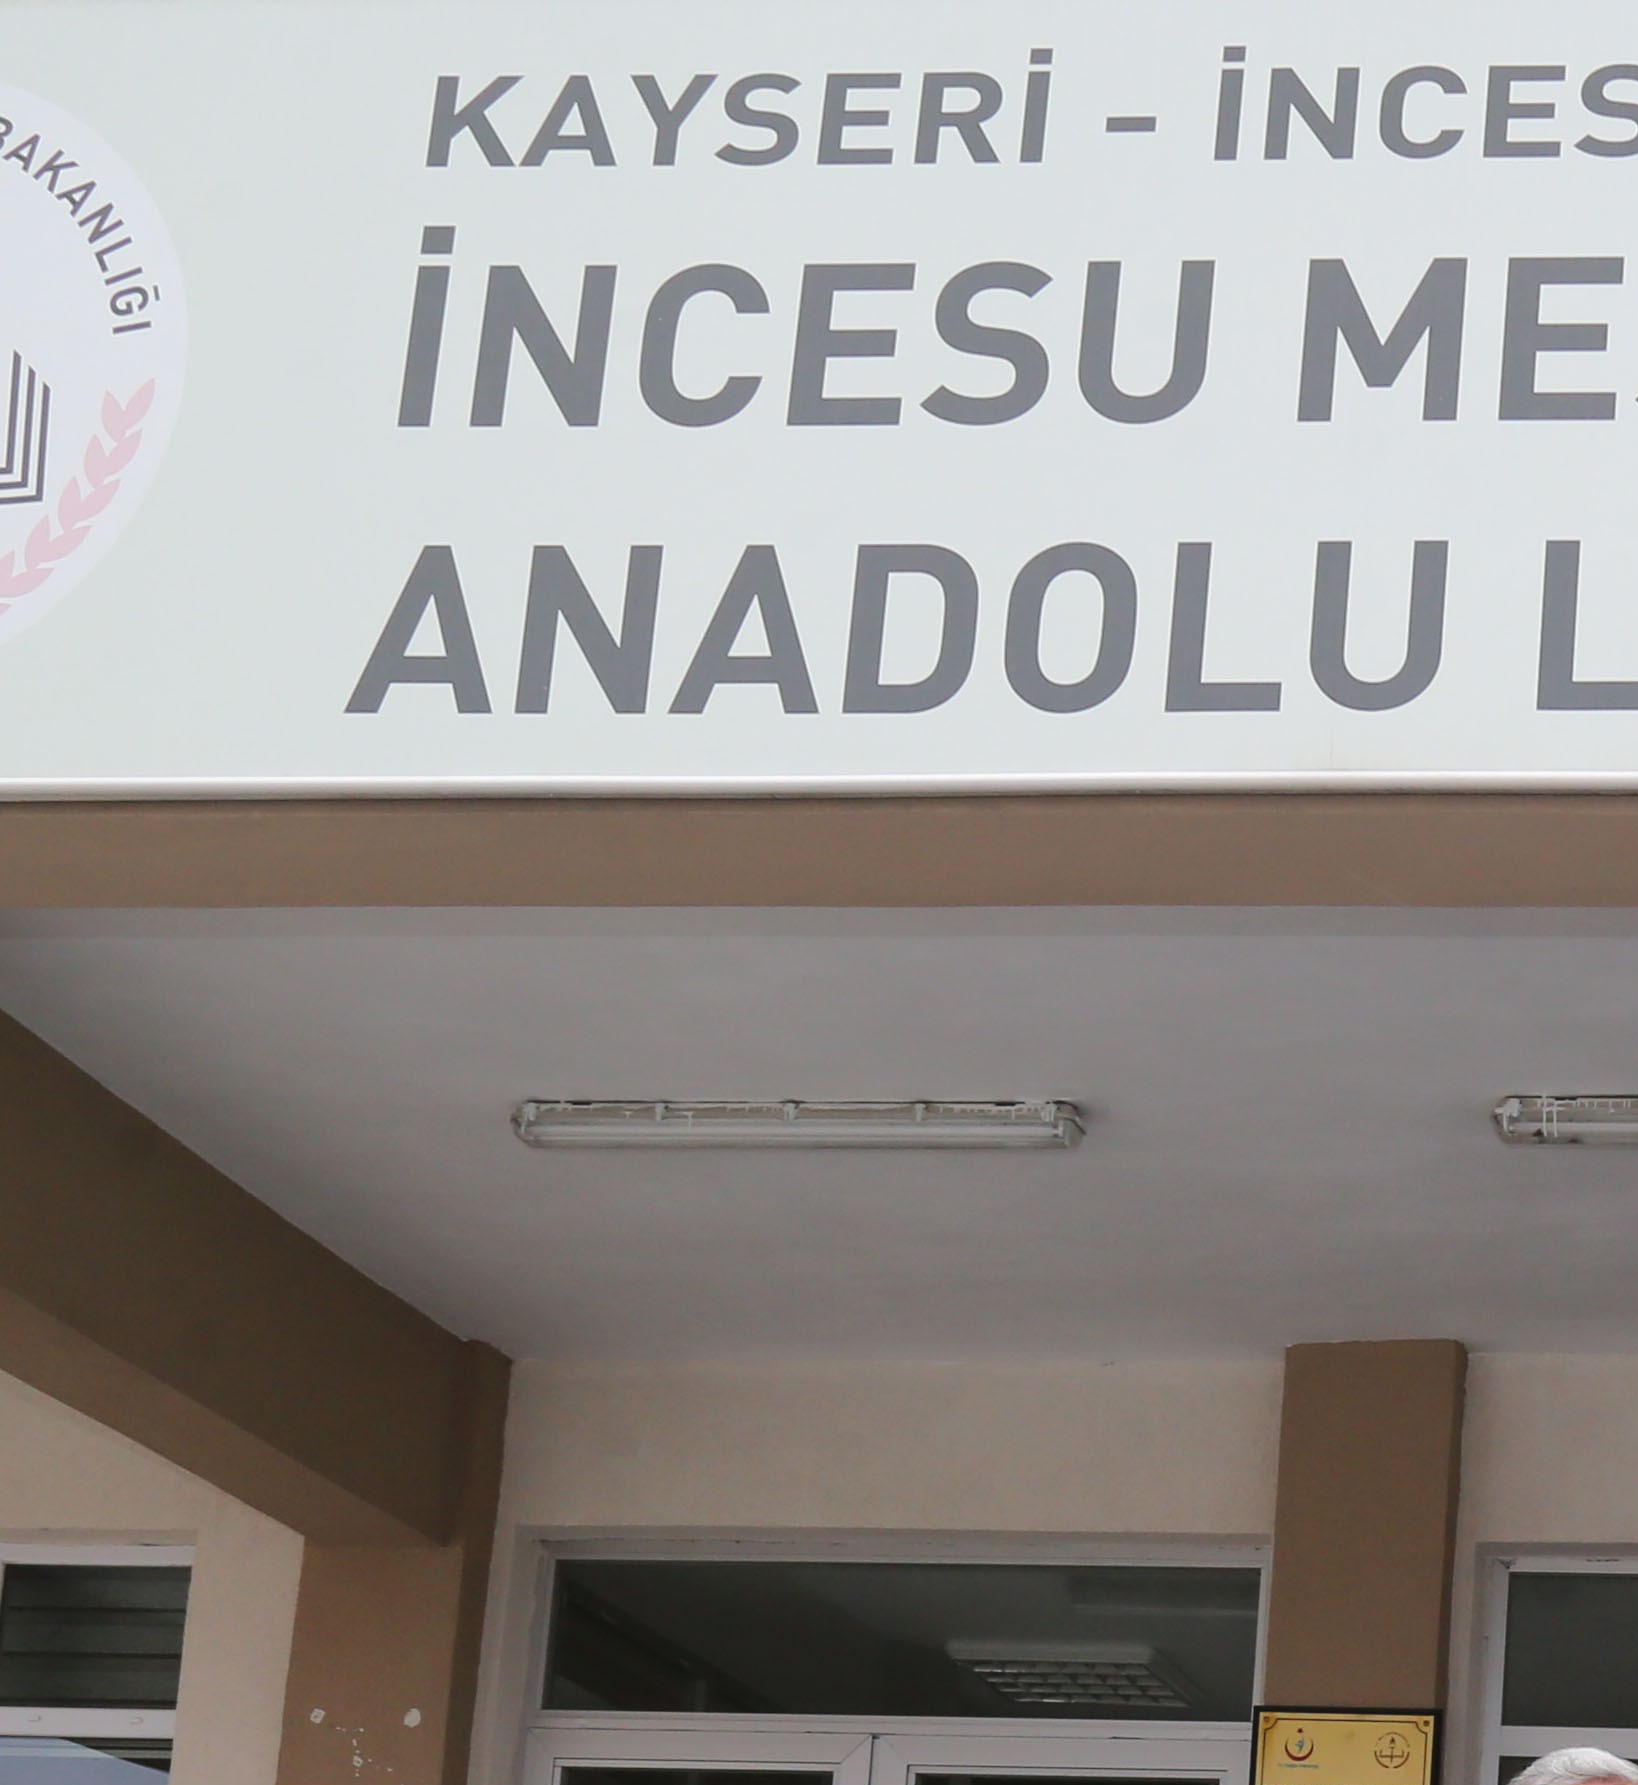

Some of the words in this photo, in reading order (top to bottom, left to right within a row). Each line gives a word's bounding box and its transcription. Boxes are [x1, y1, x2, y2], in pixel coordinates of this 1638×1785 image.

[426, 48, 1053, 168] KAYSERİ
[397, 225, 1215, 428] İNCESU
[344, 540, 1449, 715] ANADOLU
